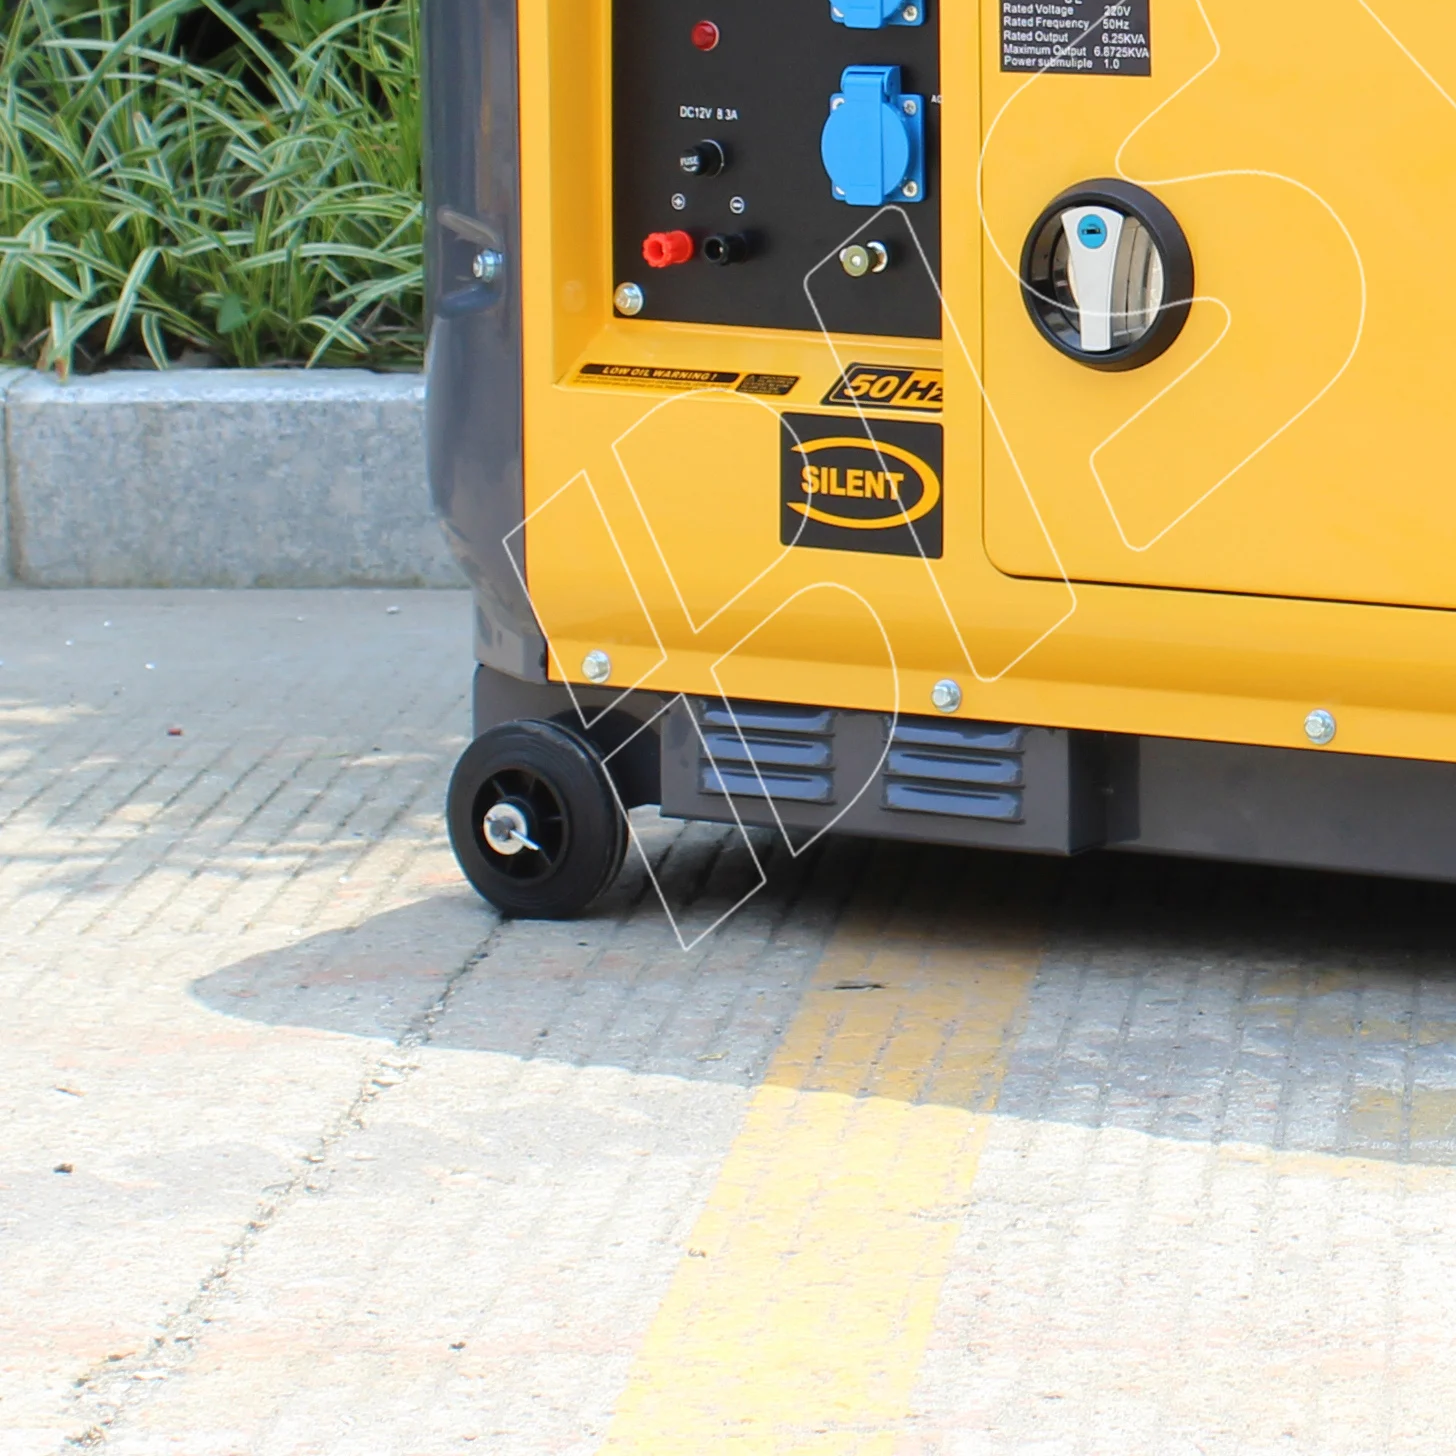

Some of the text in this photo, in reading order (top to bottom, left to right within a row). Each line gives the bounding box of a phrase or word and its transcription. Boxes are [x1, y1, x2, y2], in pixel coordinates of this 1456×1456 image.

[1003, 3, 1034, 15] Rated
[1035, 4, 1074, 17] Voltage
[1003, 15, 1130, 31] Rated Frequency 50Hz
[1003, 30, 1146, 45] Rated Output 6.25KVA
[1003, 43, 1150, 58] Maximum Output 6.8725KVA
[1003, 55, 1036, 67] Power
[1103, 59, 1120, 70] 1.0
[601, 366, 631, 376] LOW
[630, 368, 651, 377] OIL
[801, 465, 904, 501] SILENT
